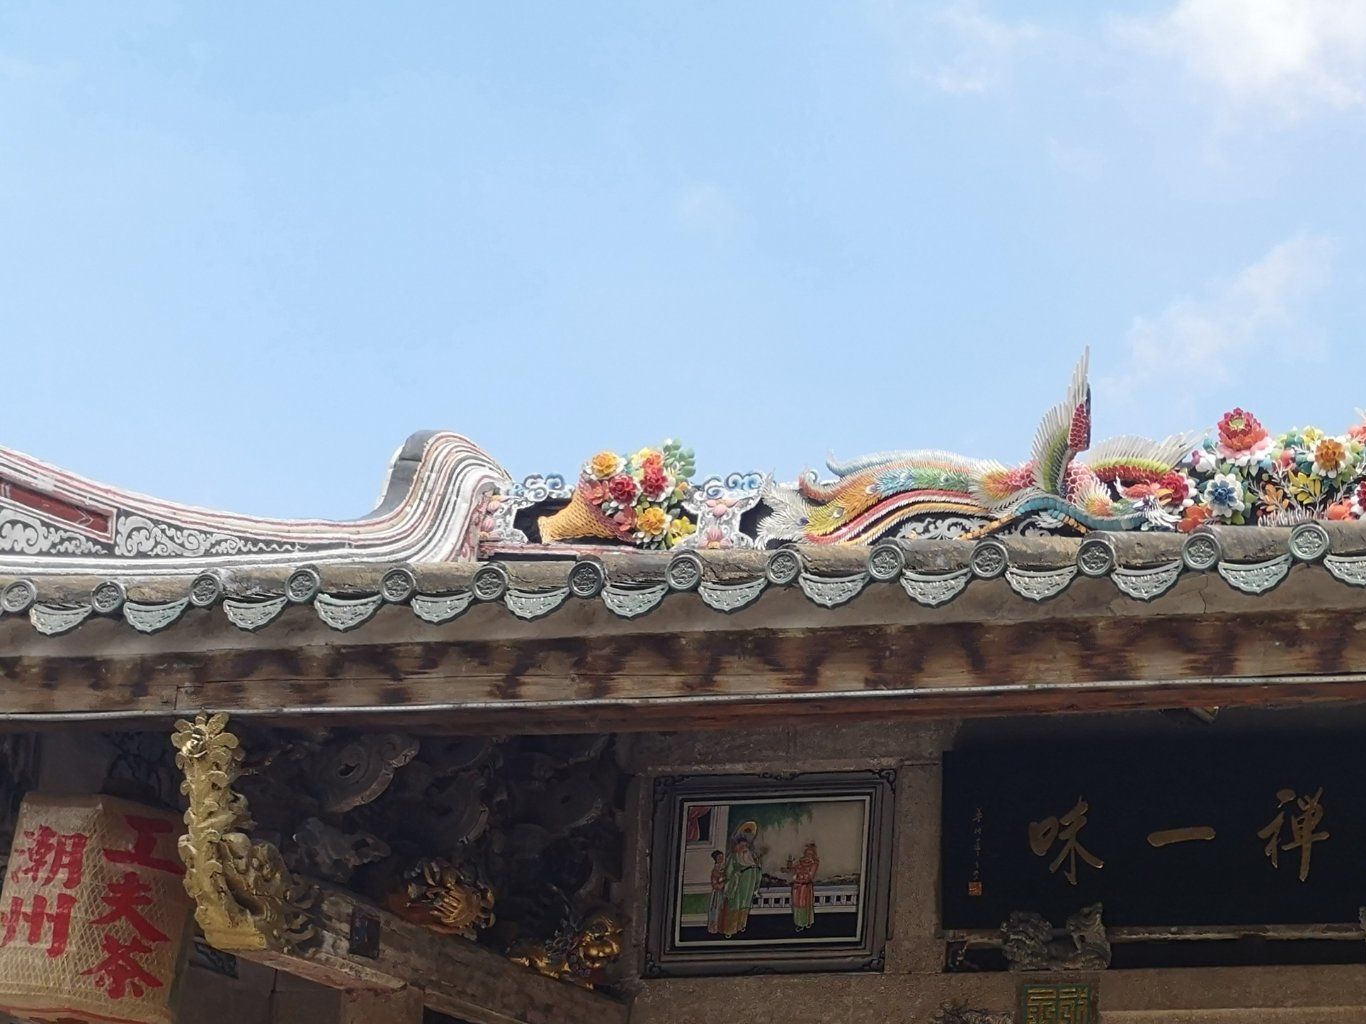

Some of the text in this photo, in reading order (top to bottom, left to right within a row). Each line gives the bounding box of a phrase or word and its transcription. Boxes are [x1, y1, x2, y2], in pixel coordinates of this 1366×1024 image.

[0, 823, 90, 959] 潮州
[80, 815, 186, 1000] 工夫茶
